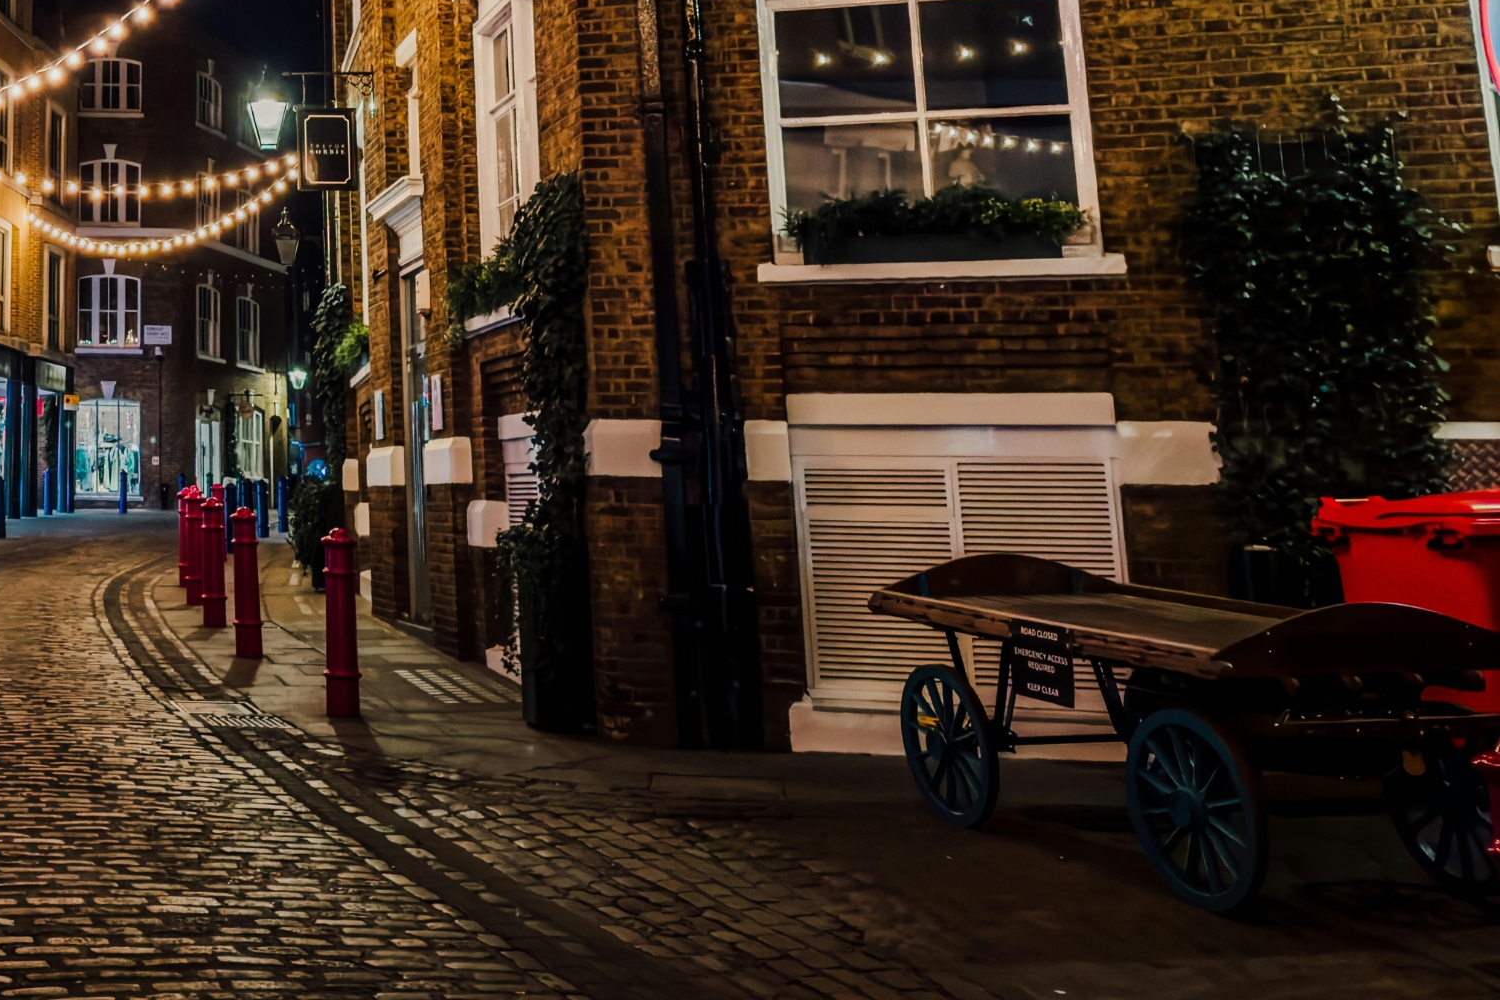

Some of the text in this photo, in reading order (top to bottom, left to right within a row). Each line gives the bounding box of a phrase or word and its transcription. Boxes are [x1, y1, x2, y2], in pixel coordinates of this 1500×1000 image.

[1020, 626, 1059, 641] ROAD CLOSED
[1014, 646, 1068, 666] EMERGENCY ACCESS
[1027, 660, 1056, 674] REQUIRED
[1026, 682, 1059, 697] KEEP CLEAR
